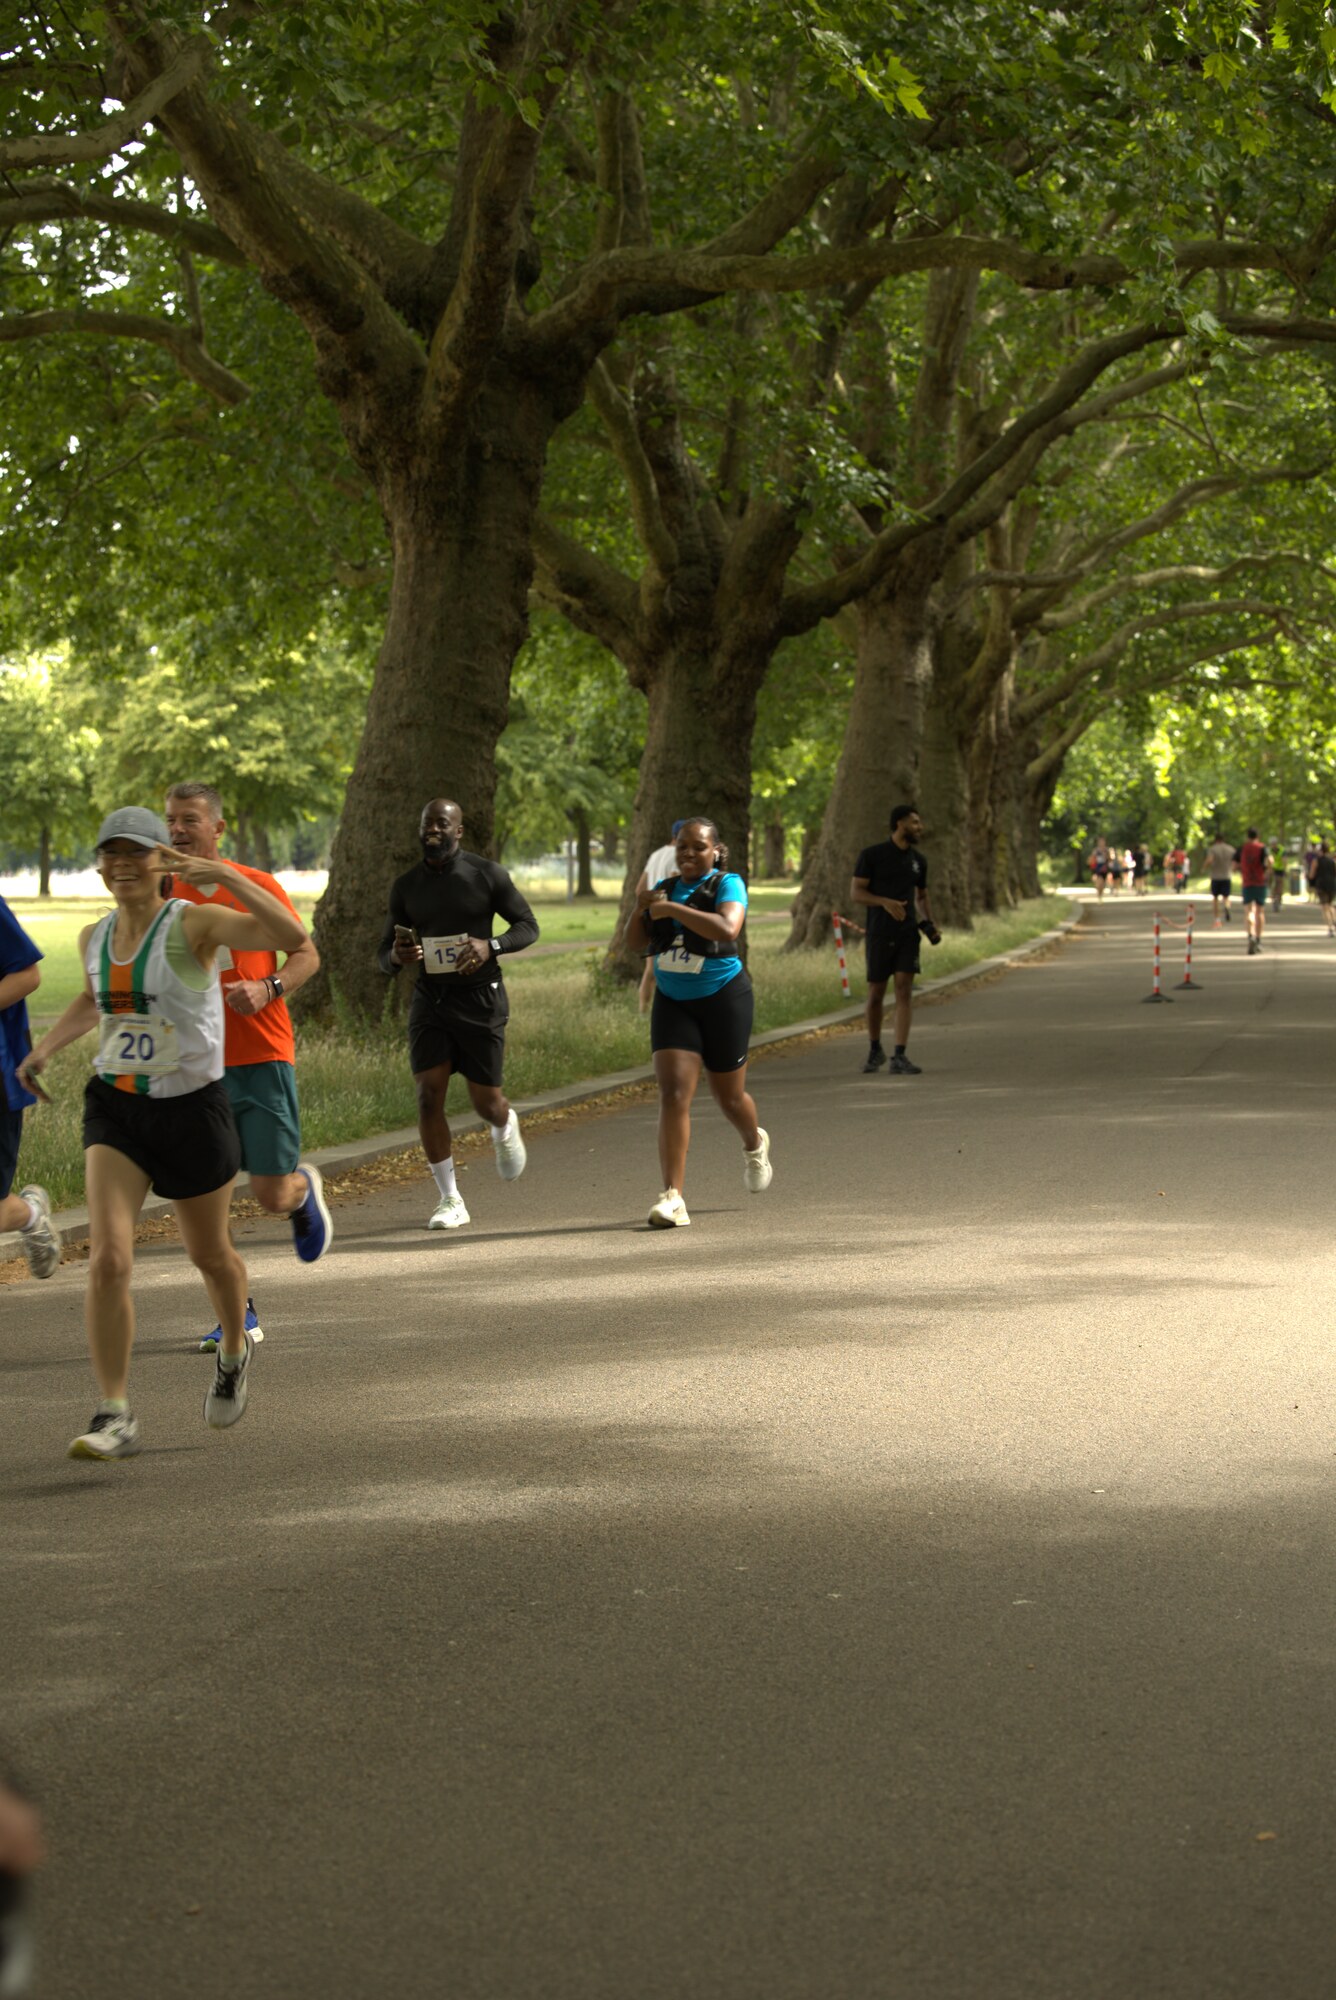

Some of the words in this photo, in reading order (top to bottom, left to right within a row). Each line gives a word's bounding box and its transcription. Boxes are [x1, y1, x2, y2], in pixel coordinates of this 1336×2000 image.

[434, 947, 457, 964] 15
[670, 947, 691, 963] 14
[119, 1032, 154, 1061] 20
